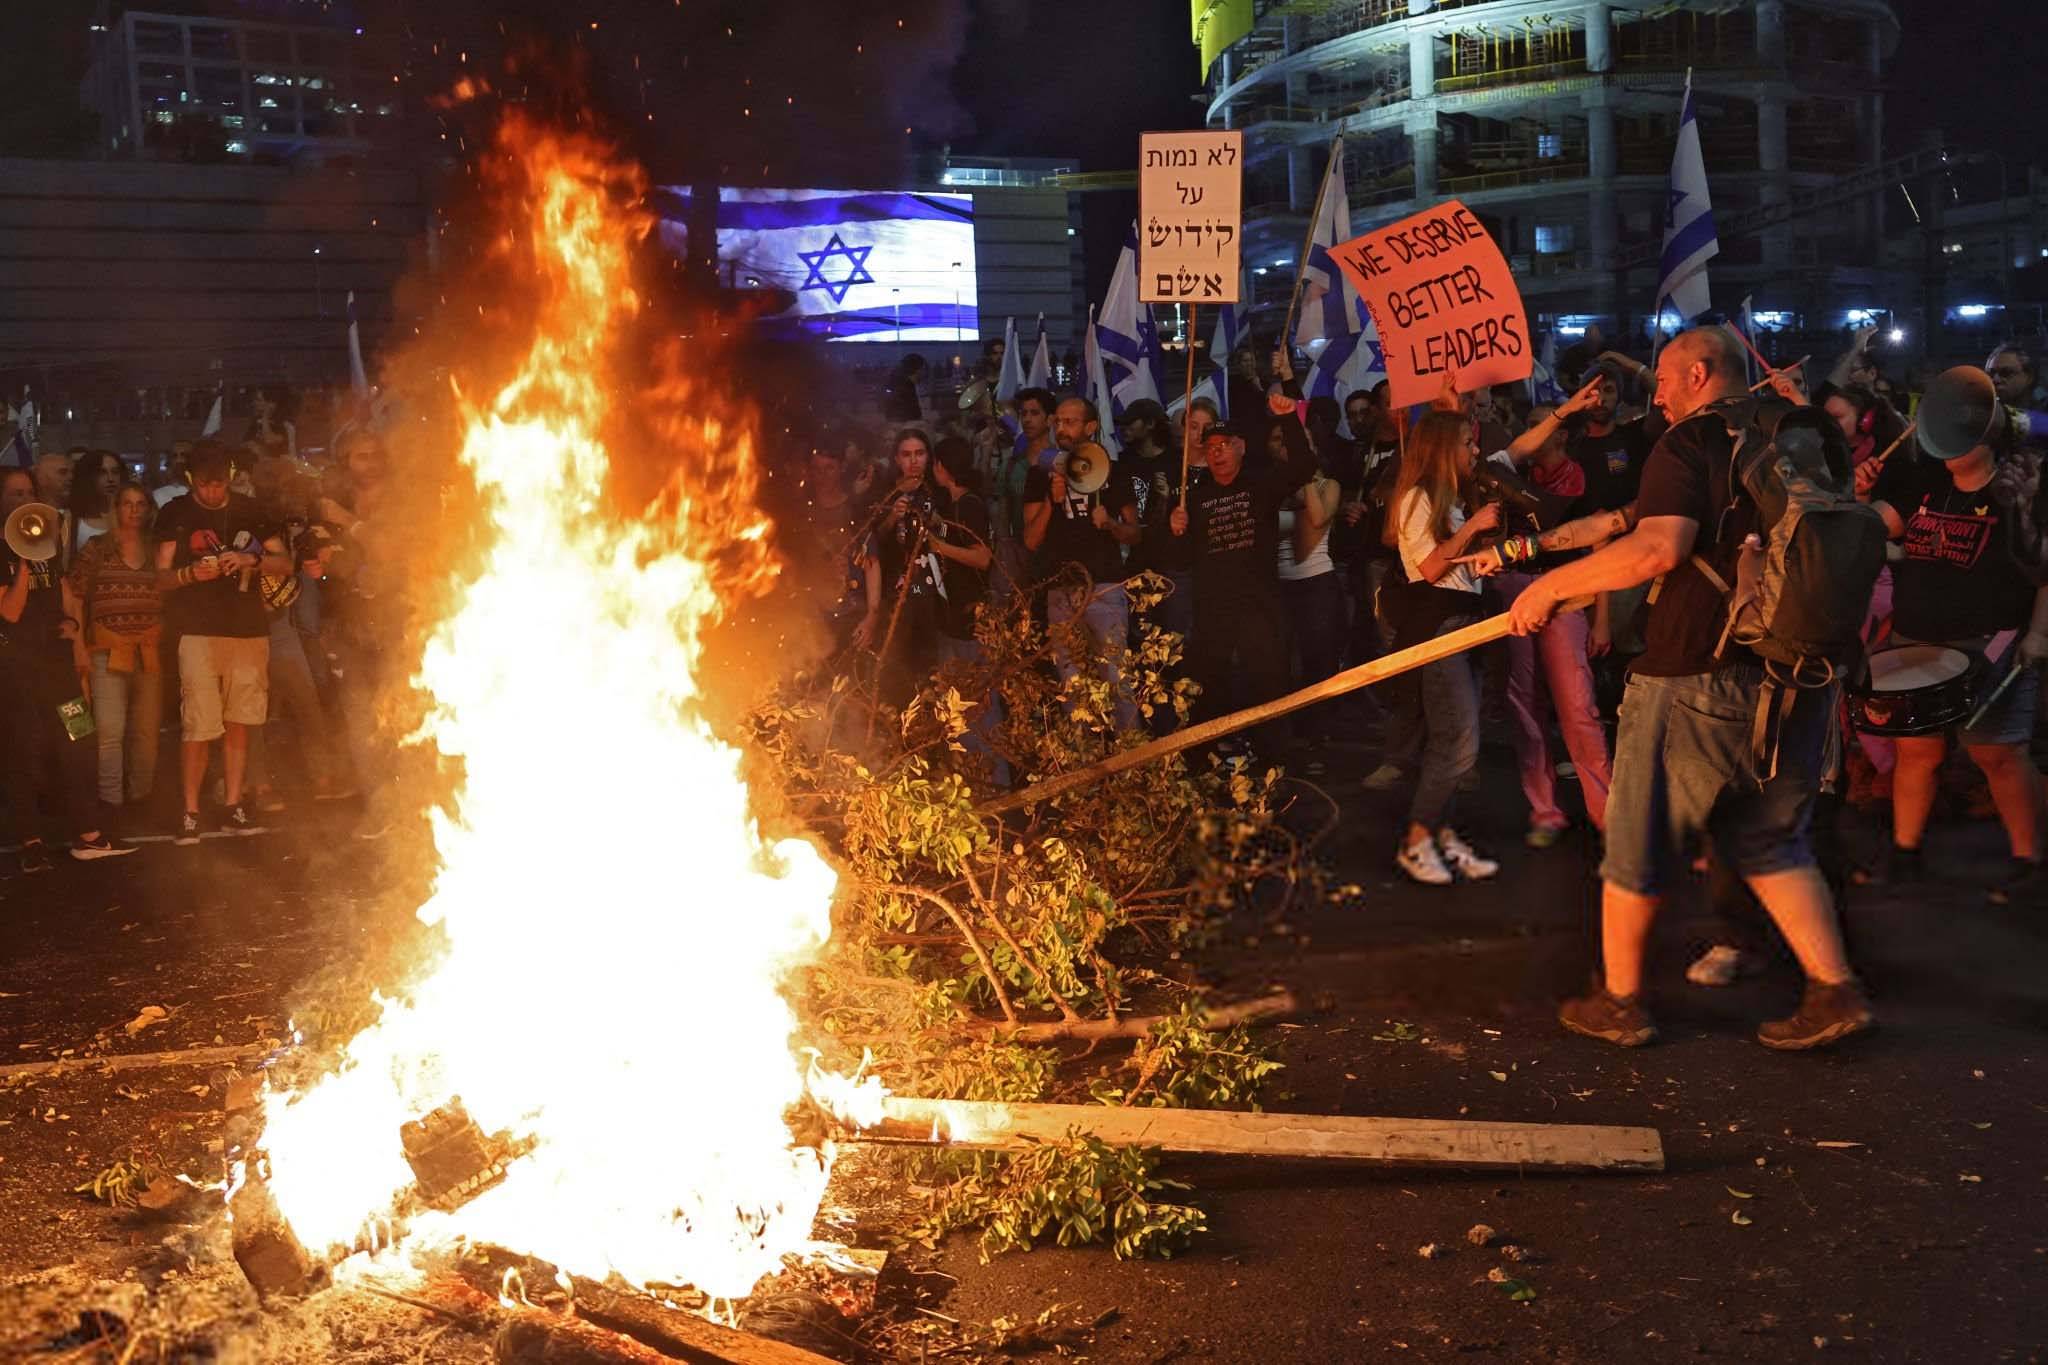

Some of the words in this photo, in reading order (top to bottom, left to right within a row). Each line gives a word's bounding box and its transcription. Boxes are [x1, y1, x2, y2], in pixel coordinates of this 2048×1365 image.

[1146, 148, 1197, 167] נמות
[1208, 142, 1236, 166] לא
[1176, 181, 1203, 205] על
[1148, 216, 1233, 258] קידוש
[1344, 244, 1391, 281] WE
[1385, 209, 1483, 265] DESERVE
[1156, 264, 1222, 297] אשם
[1388, 265, 1495, 329] BETTER
[1411, 314, 1522, 376] LEADERS
